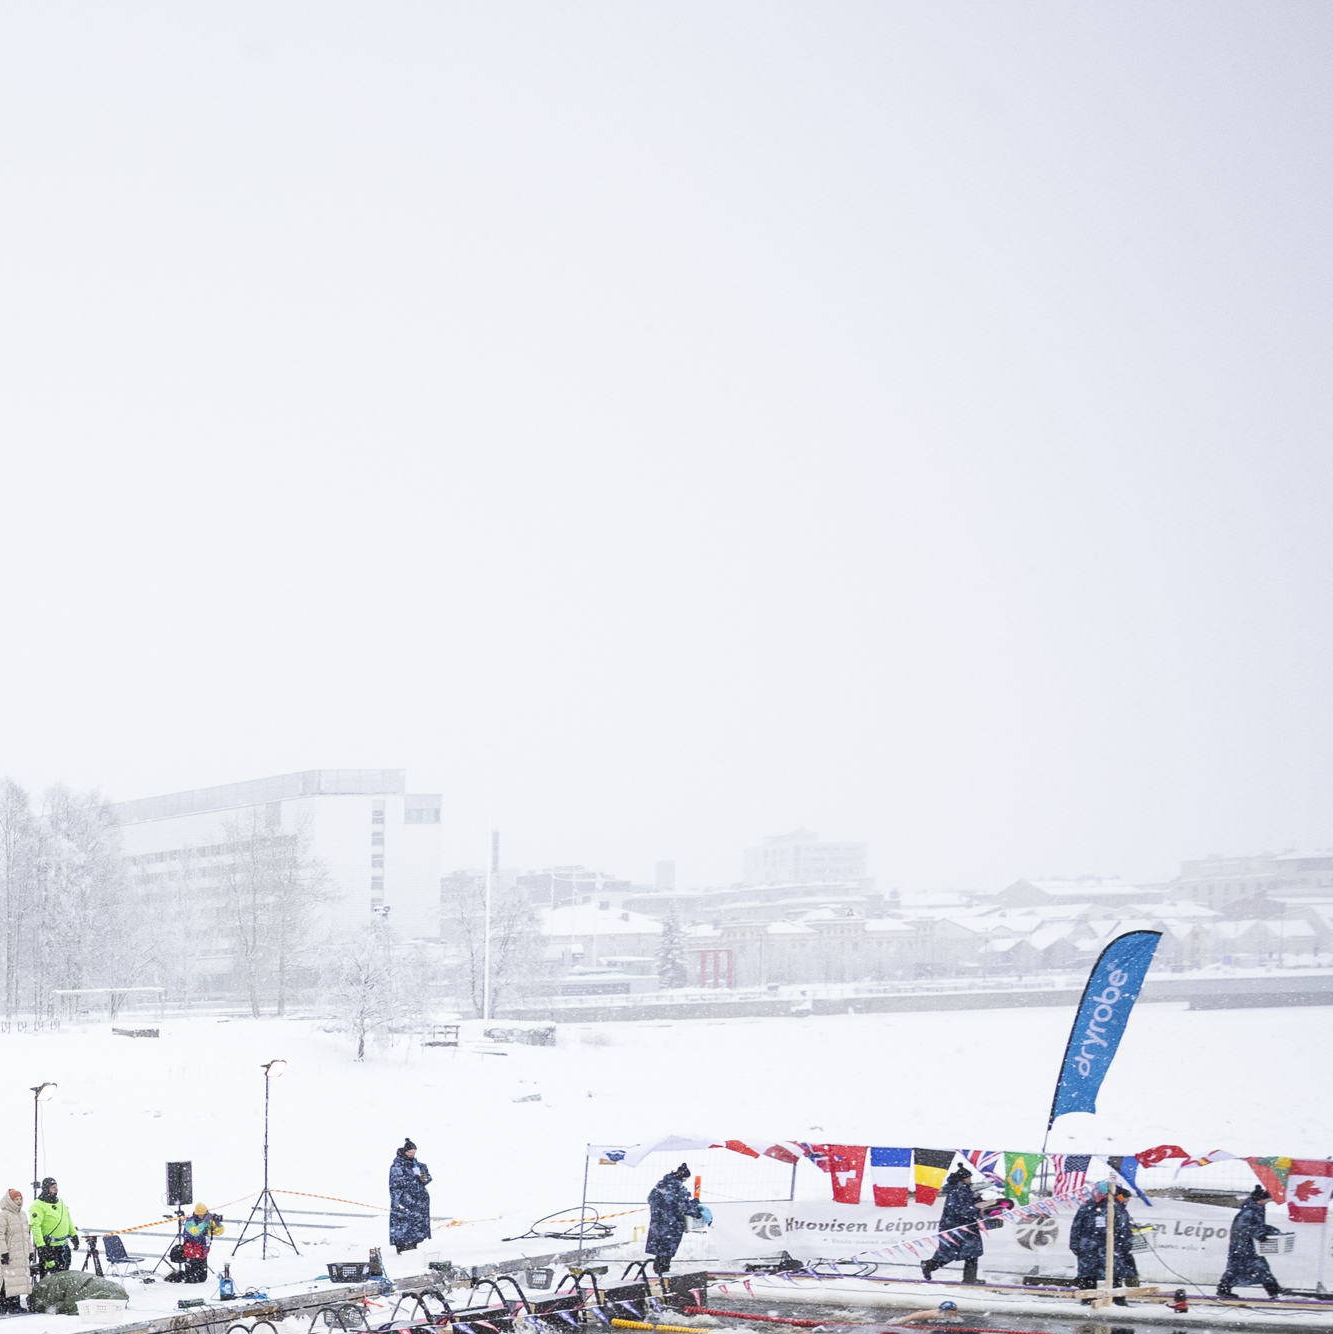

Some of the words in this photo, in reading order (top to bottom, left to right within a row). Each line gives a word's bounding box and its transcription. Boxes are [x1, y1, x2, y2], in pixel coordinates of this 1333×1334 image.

[785, 1217, 868, 1233] Huovisen
[874, 1217, 942, 1236] Leipom
[1174, 1220, 1228, 1242] Leipo
